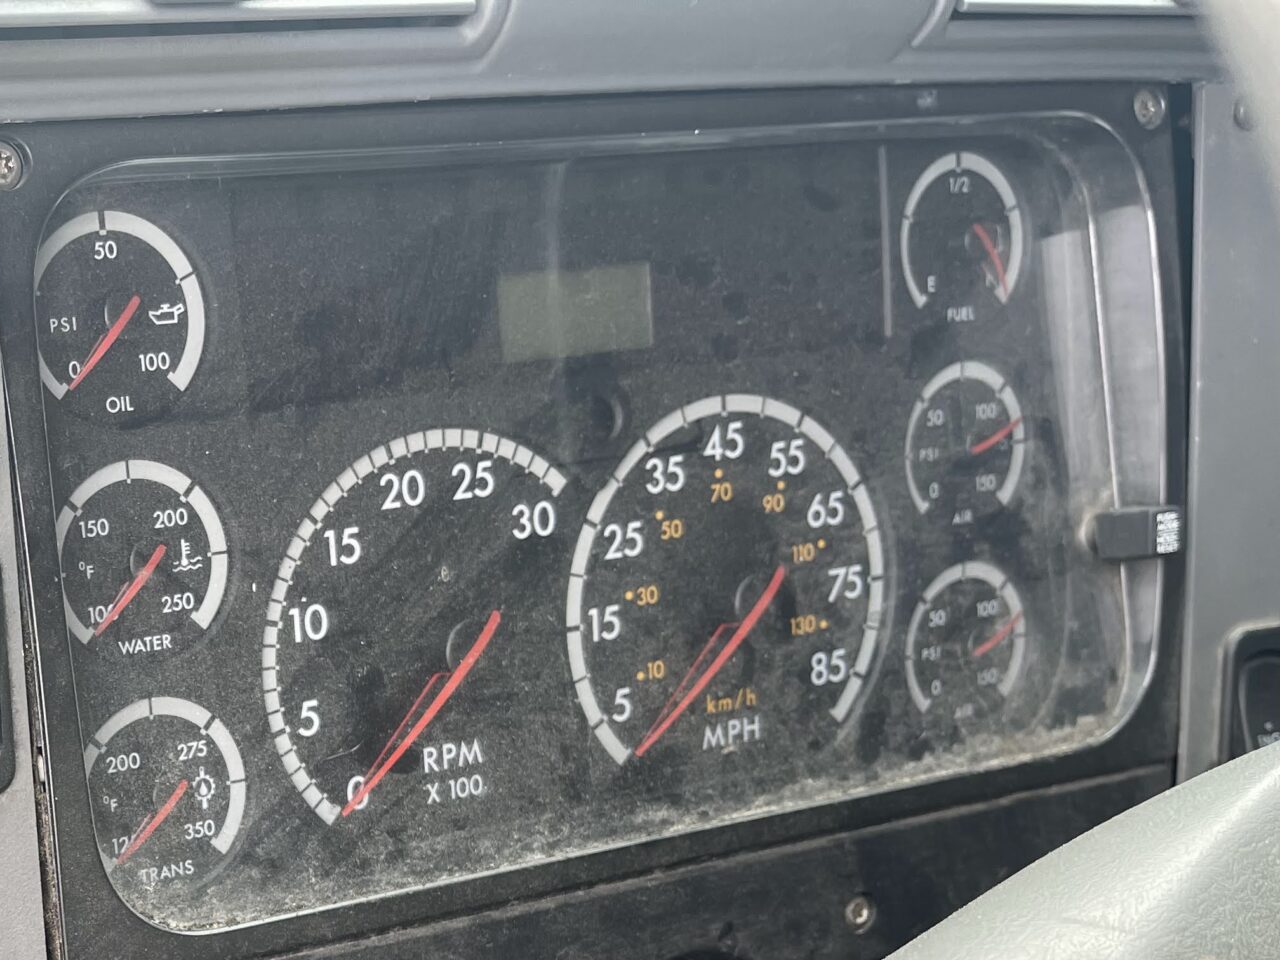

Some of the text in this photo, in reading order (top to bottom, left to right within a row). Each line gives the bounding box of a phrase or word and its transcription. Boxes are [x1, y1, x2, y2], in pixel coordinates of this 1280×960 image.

[948, 176, 969, 194] 1/2
[93, 240, 118, 260] 50
[946, 305, 975, 322] FUEL
[49, 316, 78, 334] PSI
[68, 360, 82, 379] 0
[138, 351, 171, 372] 100
[105, 395, 135, 414] OIL
[975, 402, 997, 419] 100
[926, 409, 945, 427] 50
[702, 421, 745, 462] 45
[768, 439, 806, 478] 55
[450, 460, 495, 500] 25
[644, 455, 686, 495] 35
[975, 474, 997, 492] 150
[379, 469, 426, 511] 20
[710, 482, 733, 503] 70
[928, 481, 940, 499] 0
[762, 493, 785, 514] 90
[806, 491, 845, 528] 65
[152, 507, 189, 529] 200
[511, 500, 555, 540] 30
[951, 508, 974, 526] AIR
[78, 518, 110, 539] 150
[660, 520, 684, 541] 50
[323, 526, 363, 567] 15
[603, 520, 644, 561] 25
[792, 543, 816, 563] 110
[827, 564, 863, 603] 75
[161, 592, 195, 614] 250
[636, 585, 659, 606] 30
[928, 609, 946, 628] 50
[976, 600, 999, 618] 100
[287, 603, 328, 644] 10
[587, 604, 621, 643] 15
[789, 616, 817, 636] 130
[117, 633, 173, 656] WATER
[646, 659, 665, 680] 10
[809, 648, 847, 687] 85
[611, 687, 632, 723] 5
[706, 688, 757, 715] km/h
[297, 699, 321, 738] 5
[702, 714, 761, 751] MPH
[177, 739, 208, 761] 275
[422, 739, 483, 774] RPM
[105, 752, 141, 774] 200
[346, 775, 370, 810] 0
[425, 775, 484, 805] X 100
[183, 819, 216, 840] 350
[140, 859, 195, 883] TRANS
